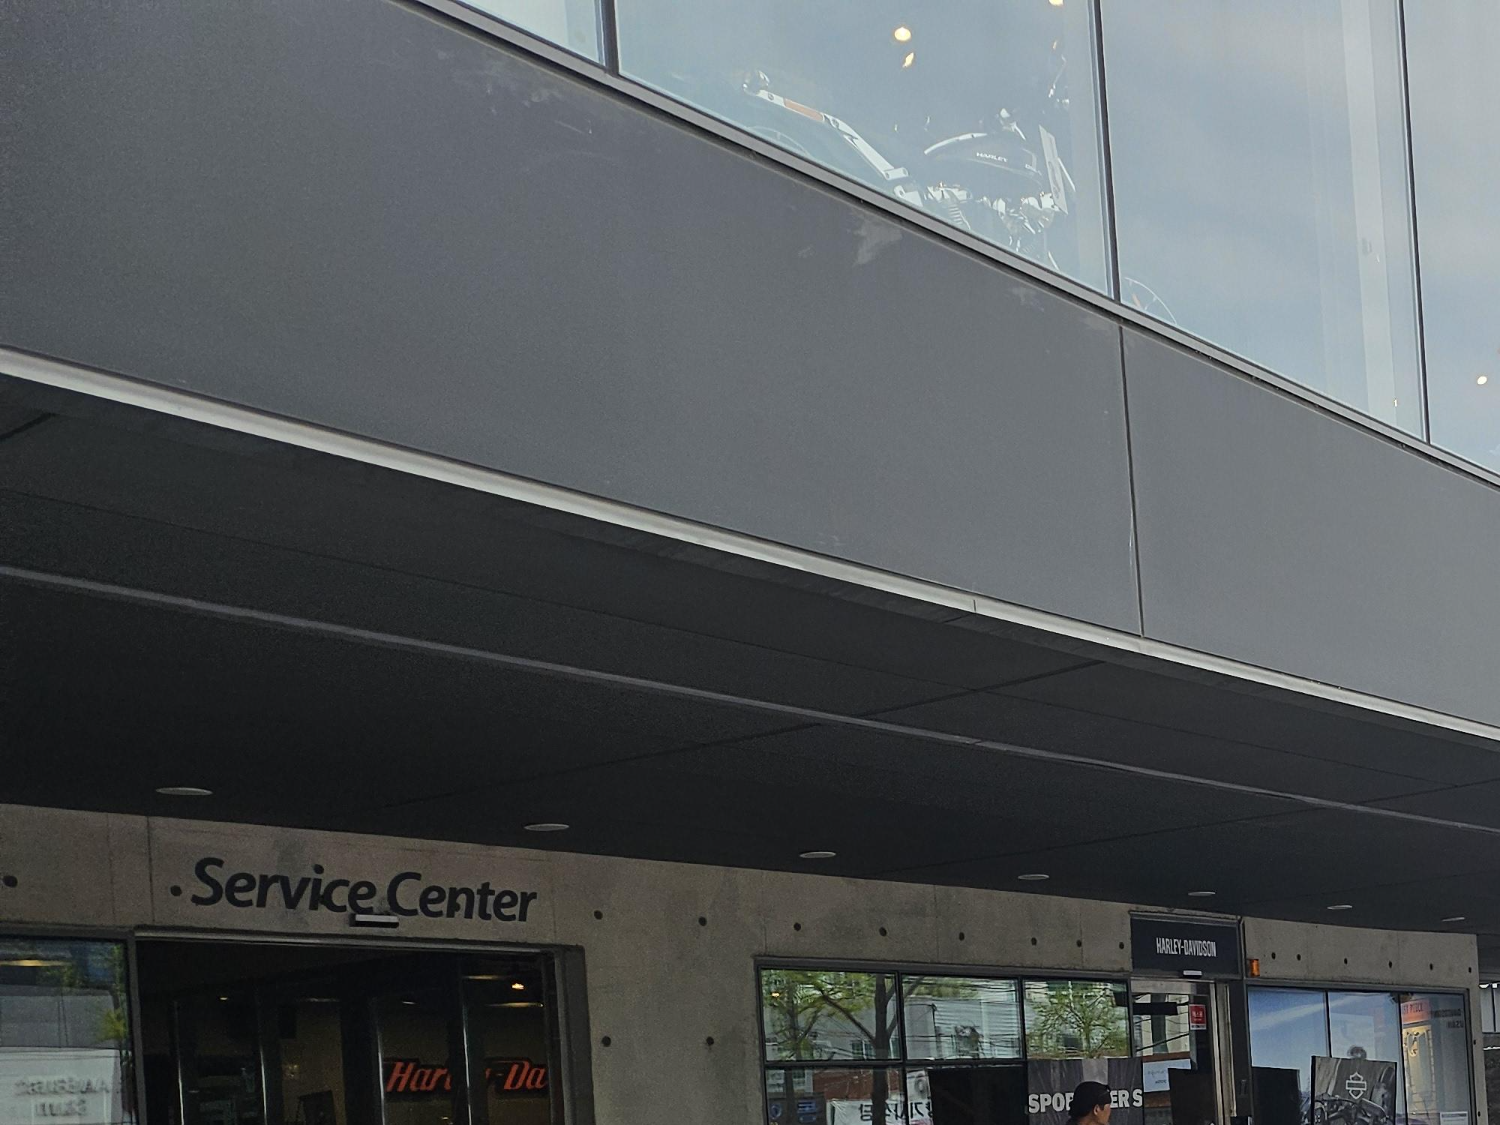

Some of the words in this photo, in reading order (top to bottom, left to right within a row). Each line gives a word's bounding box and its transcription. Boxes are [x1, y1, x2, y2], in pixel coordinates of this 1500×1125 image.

[191, 857, 377, 915] Service
[387, 871, 537, 922] Center
[1156, 937, 1217, 957] HARLEY-DAVIDSON
[1028, 1089, 1143, 1114] SPORERS
